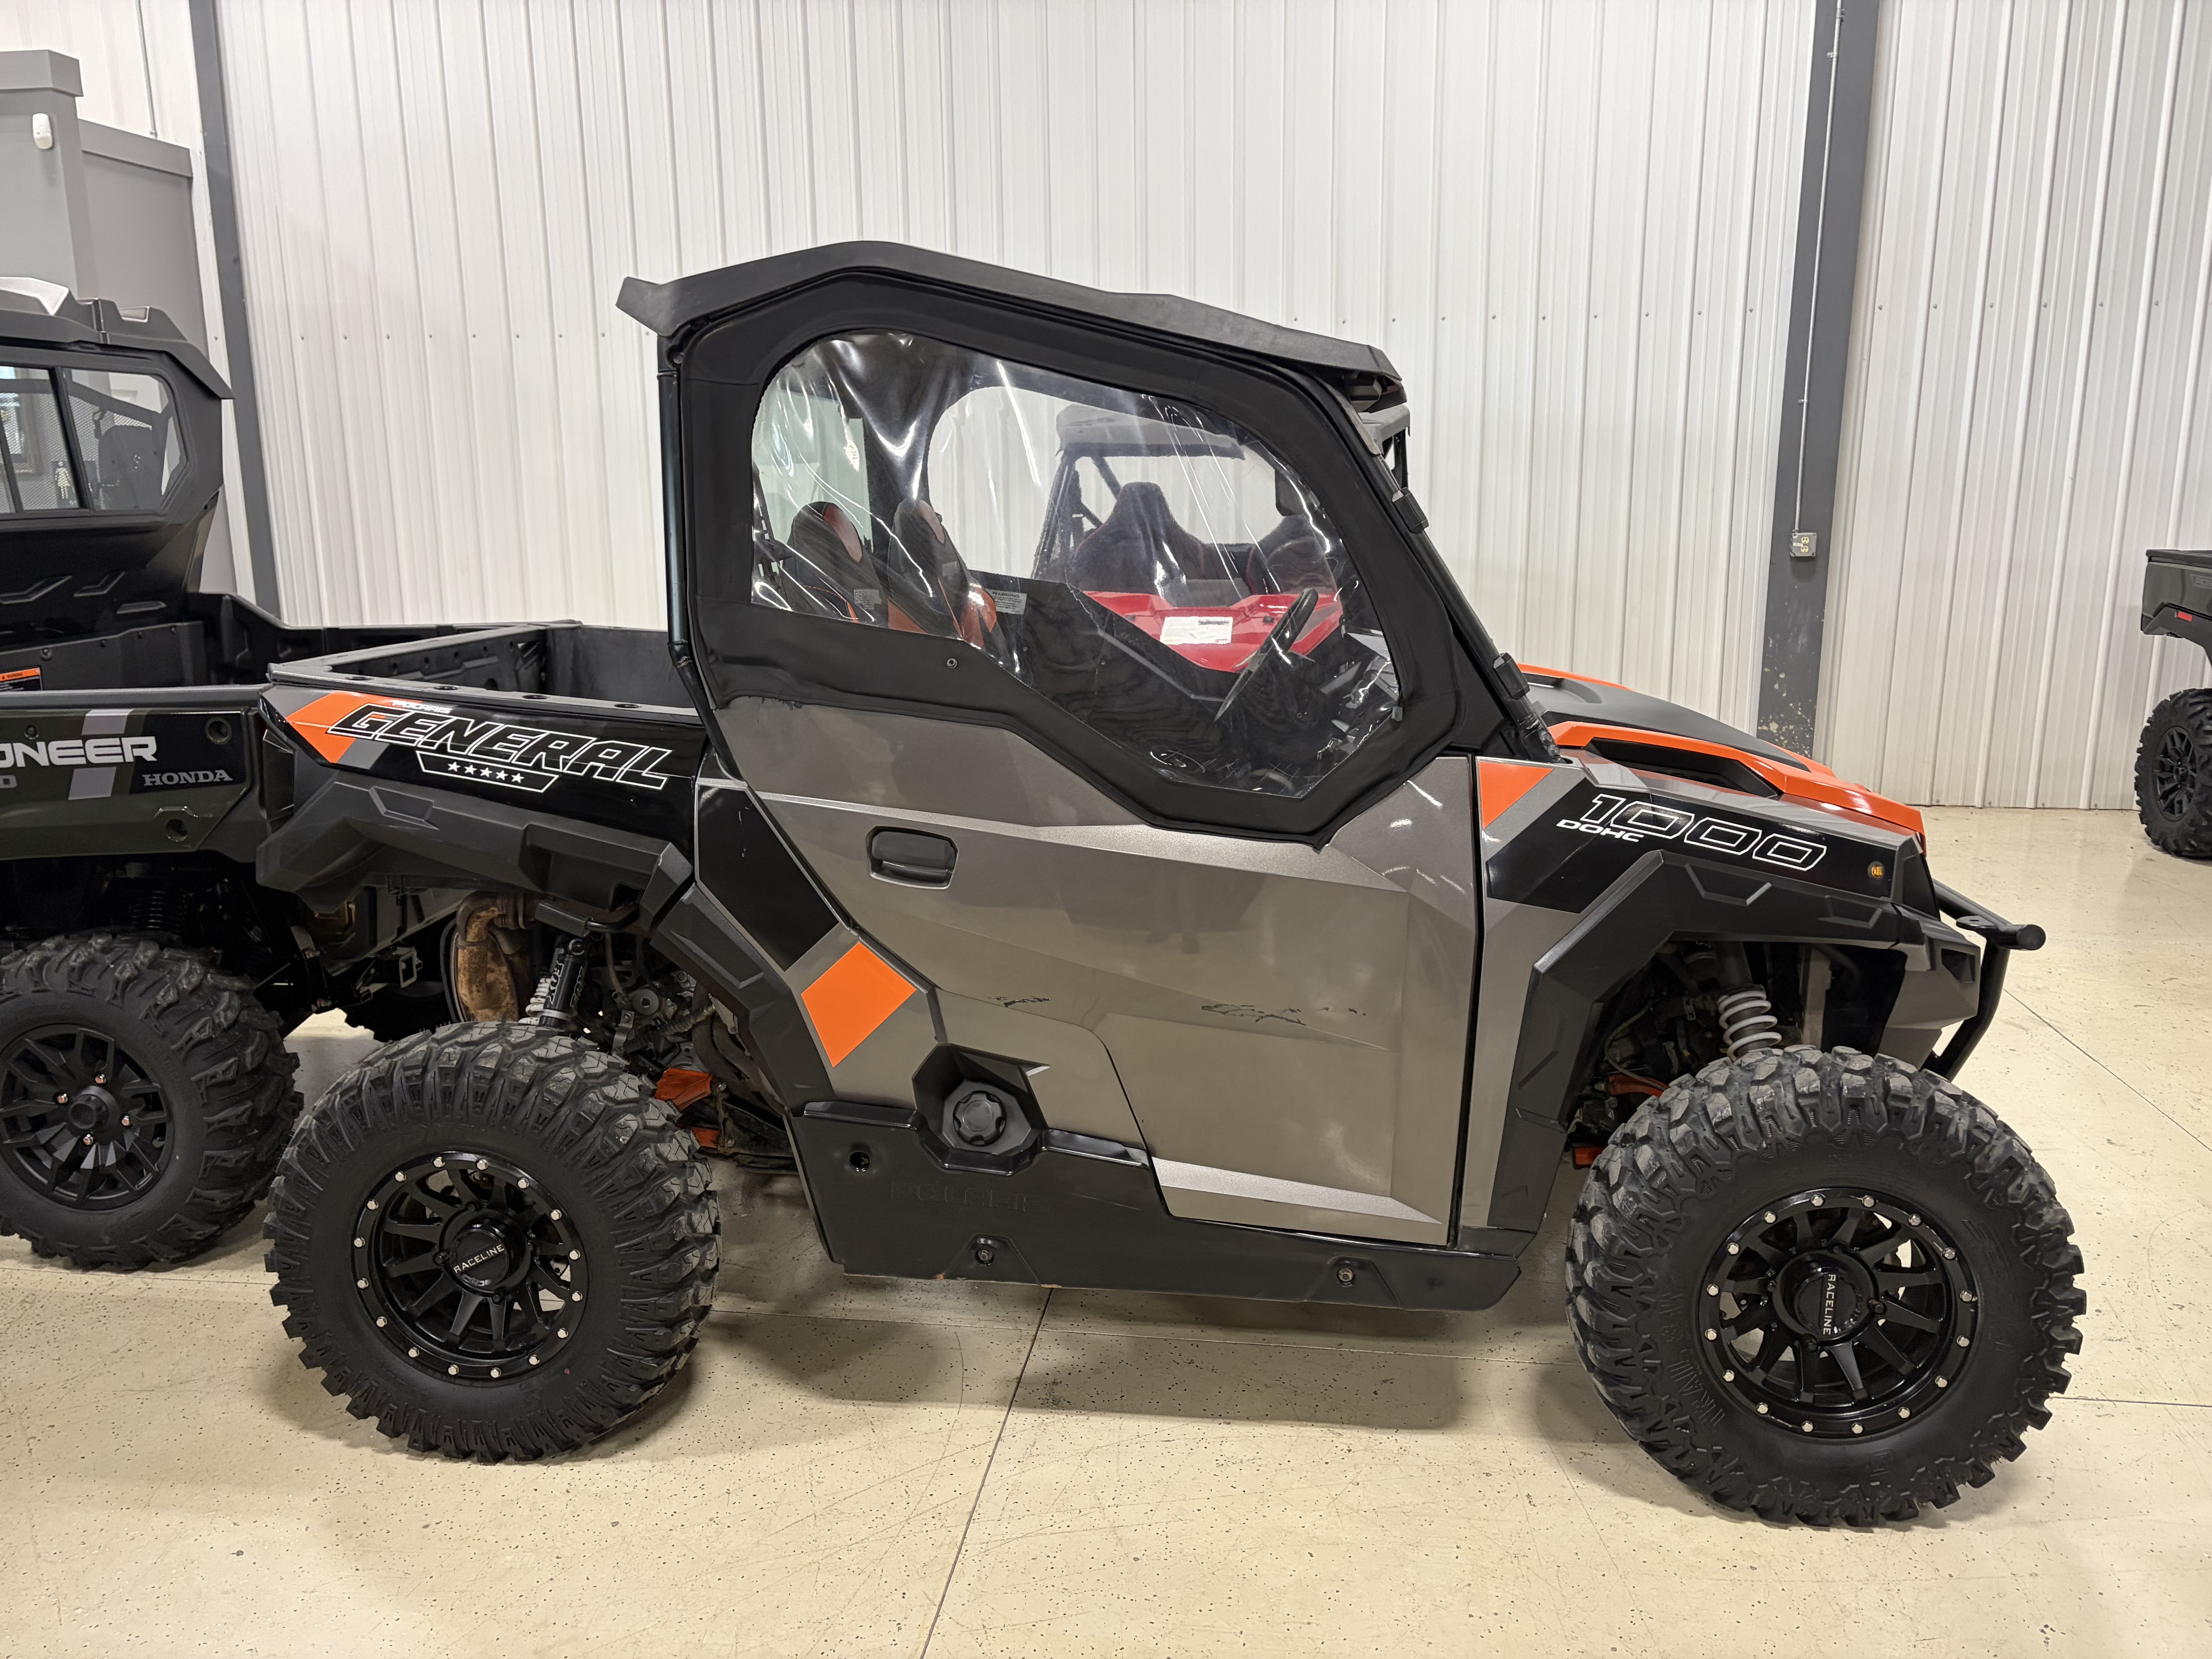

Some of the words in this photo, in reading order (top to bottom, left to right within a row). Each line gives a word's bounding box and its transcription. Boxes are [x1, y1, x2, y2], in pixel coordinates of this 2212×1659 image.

[392, 700, 453, 714] POLARIS
[327, 703, 672, 790] GENERAL
[142, 769, 233, 787] HONDA
[1556, 819, 1644, 843] DOHC
[1580, 793, 1827, 871] 1000
[453, 1244, 505, 1273] RACELINE
[1823, 1274, 1836, 1335] RACELINE
